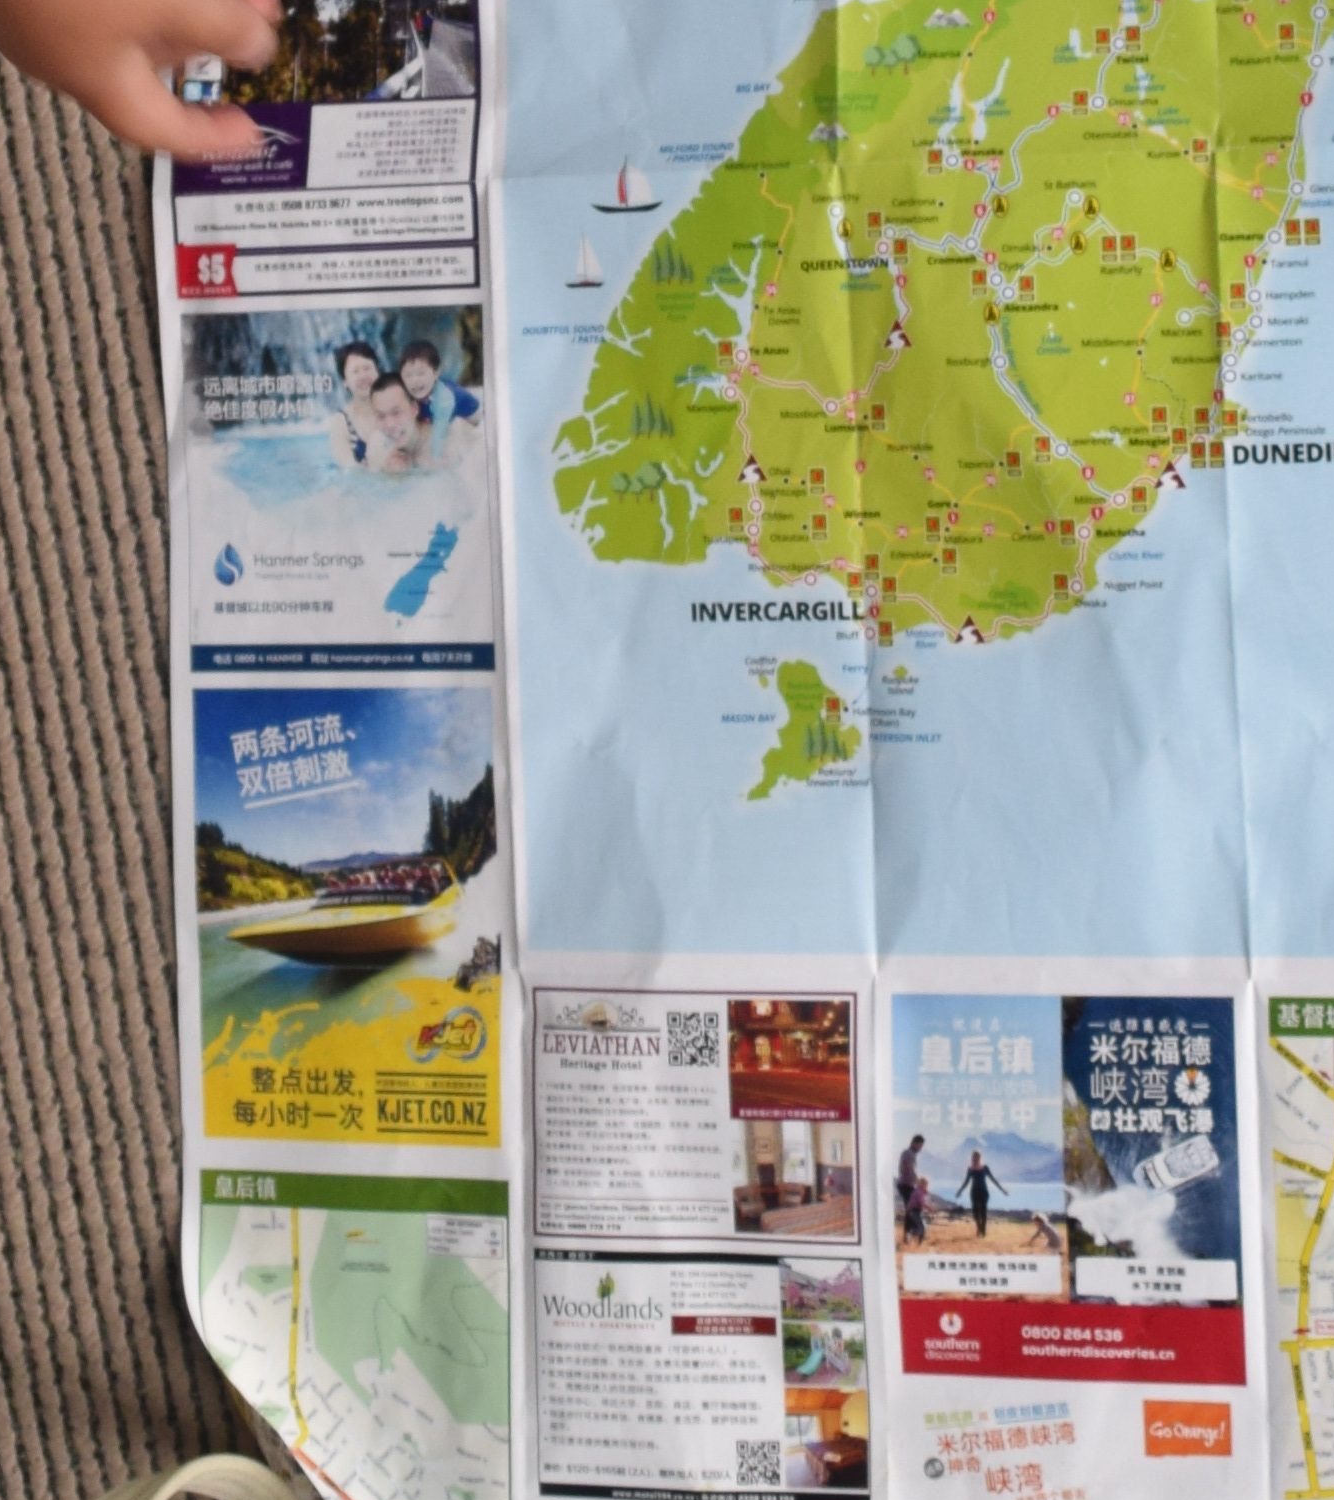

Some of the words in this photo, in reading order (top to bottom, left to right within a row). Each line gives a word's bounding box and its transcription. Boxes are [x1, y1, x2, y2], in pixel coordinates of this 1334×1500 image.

[197, 255, 226, 286] $5
[799, 257, 889, 273] QUEENSTOWN
[253, 552, 310, 568] Hanmer
[313, 550, 365, 571] Springs
[690, 600, 867, 623] INVERCARGILL
[230, 713, 358, 764] 两条河流、
[238, 749, 352, 799] 双倍刺激
[541, 1032, 662, 1057] LEVIATHAN
[919, 1035, 1035, 1076] 皇后镇
[1088, 1035, 1213, 1066] 米尔福德
[560, 1057, 608, 1072] Heritage
[611, 1057, 643, 1071] Hotel
[251, 1065, 365, 1099] 整点出发，
[1089, 1070, 1168, 1107] 峡湾
[231, 1098, 365, 1132] 每小时一次
[376, 1097, 489, 1128] KJET.CO.NZ
[214, 1175, 278, 1201] 皇后镇
[543, 1294, 664, 1321] Woodlands
[924, 1337, 980, 1352] southern
[1021, 1325, 1061, 1341] 0800
[1063, 1326, 1092, 1341] 264
[1093, 1327, 1123, 1343] 536
[924, 1350, 981, 1362] discoveries
[1021, 1344, 1176, 1362] southerndiscoveries.cn
[937, 1422, 1077, 1455] 米尔福德峡湾
[1150, 1421, 1172, 1439] Go
[1173, 1420, 1226, 1448] Orange!
[984, 1463, 1044, 1494] 峡湾
